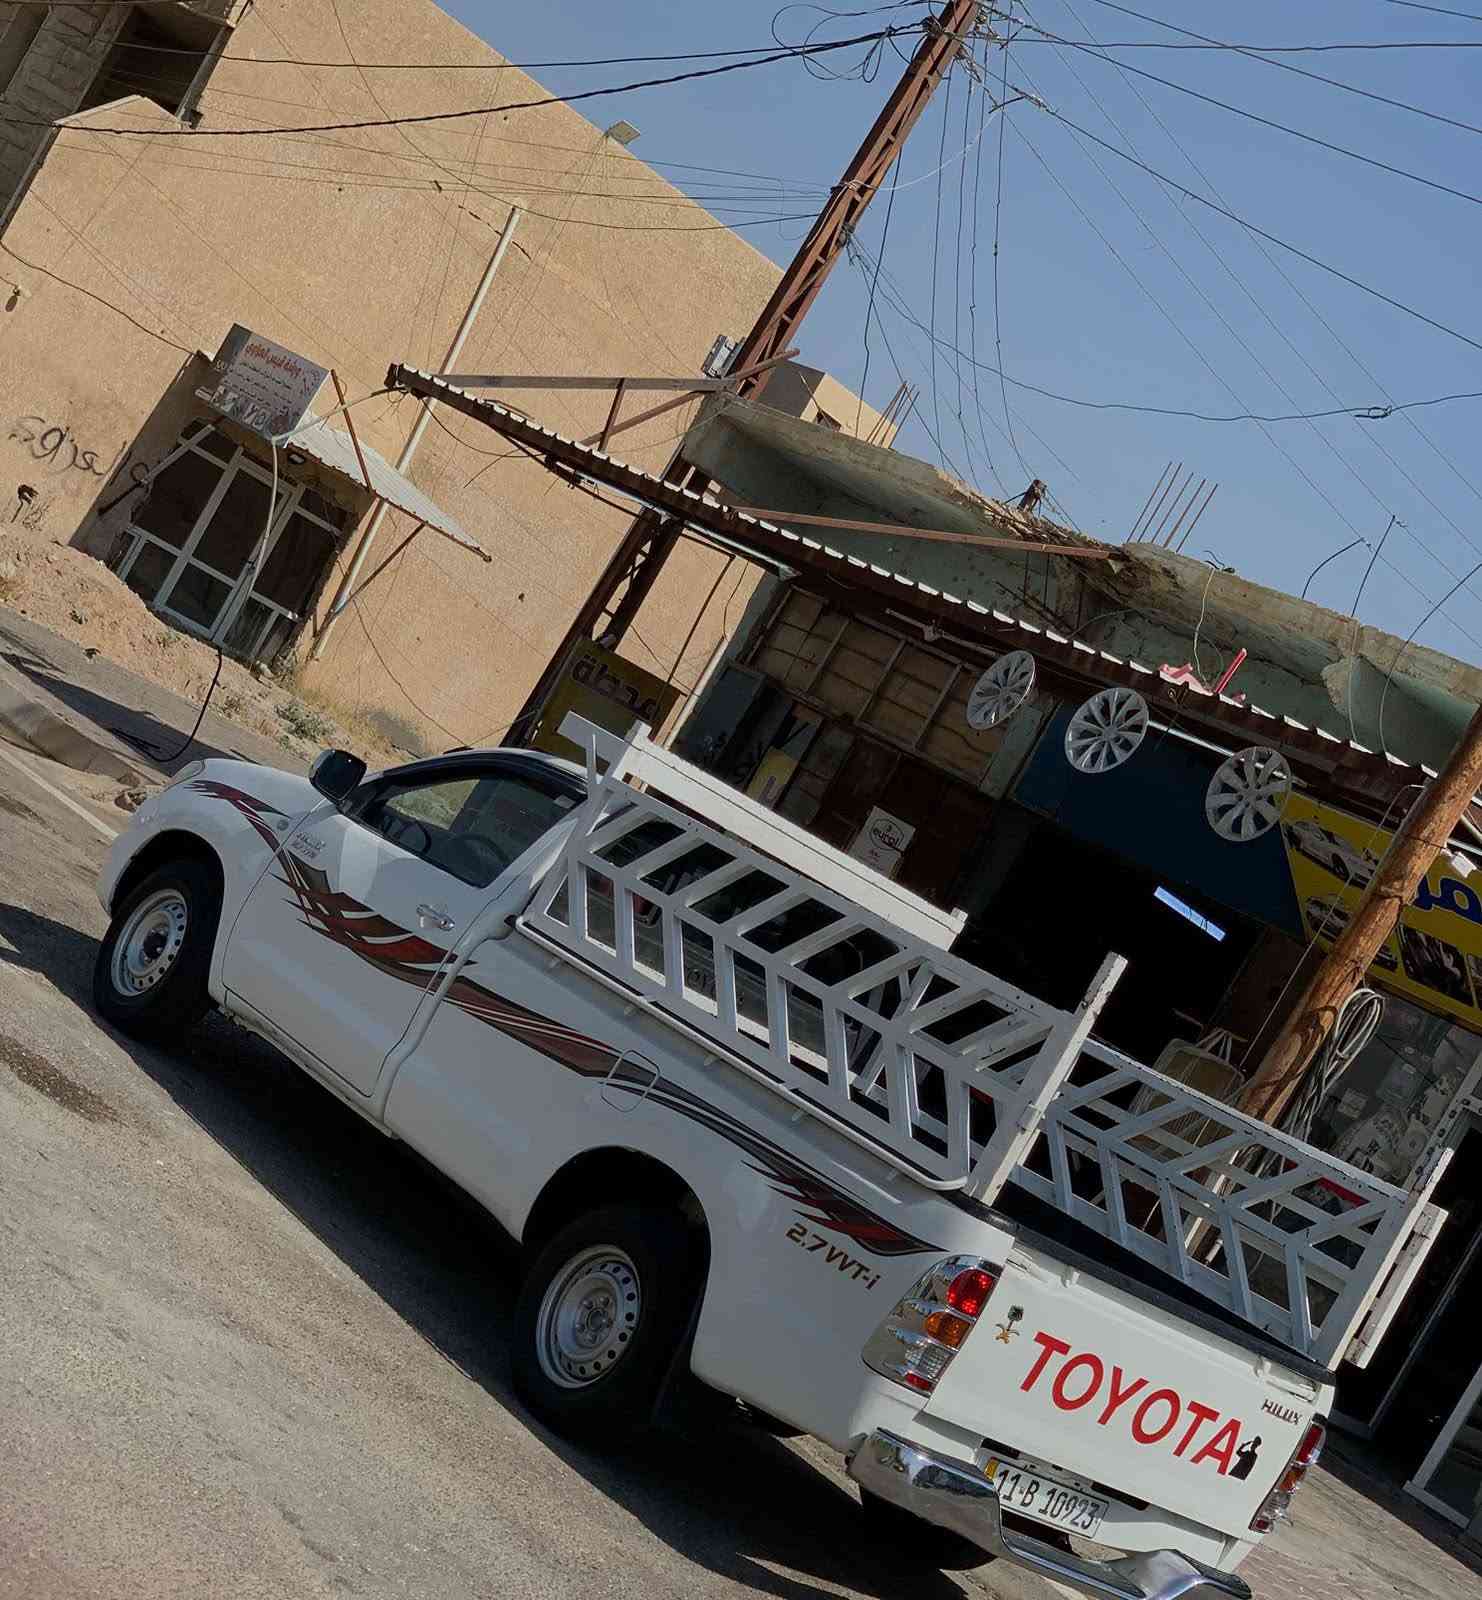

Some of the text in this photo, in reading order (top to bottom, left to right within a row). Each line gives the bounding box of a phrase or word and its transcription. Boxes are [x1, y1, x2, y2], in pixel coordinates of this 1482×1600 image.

[1020, 1331, 1242, 1476] TOYOTA
[1260, 1399, 1303, 1426] HILUX
[1038, 1487, 1100, 1530] 10923
